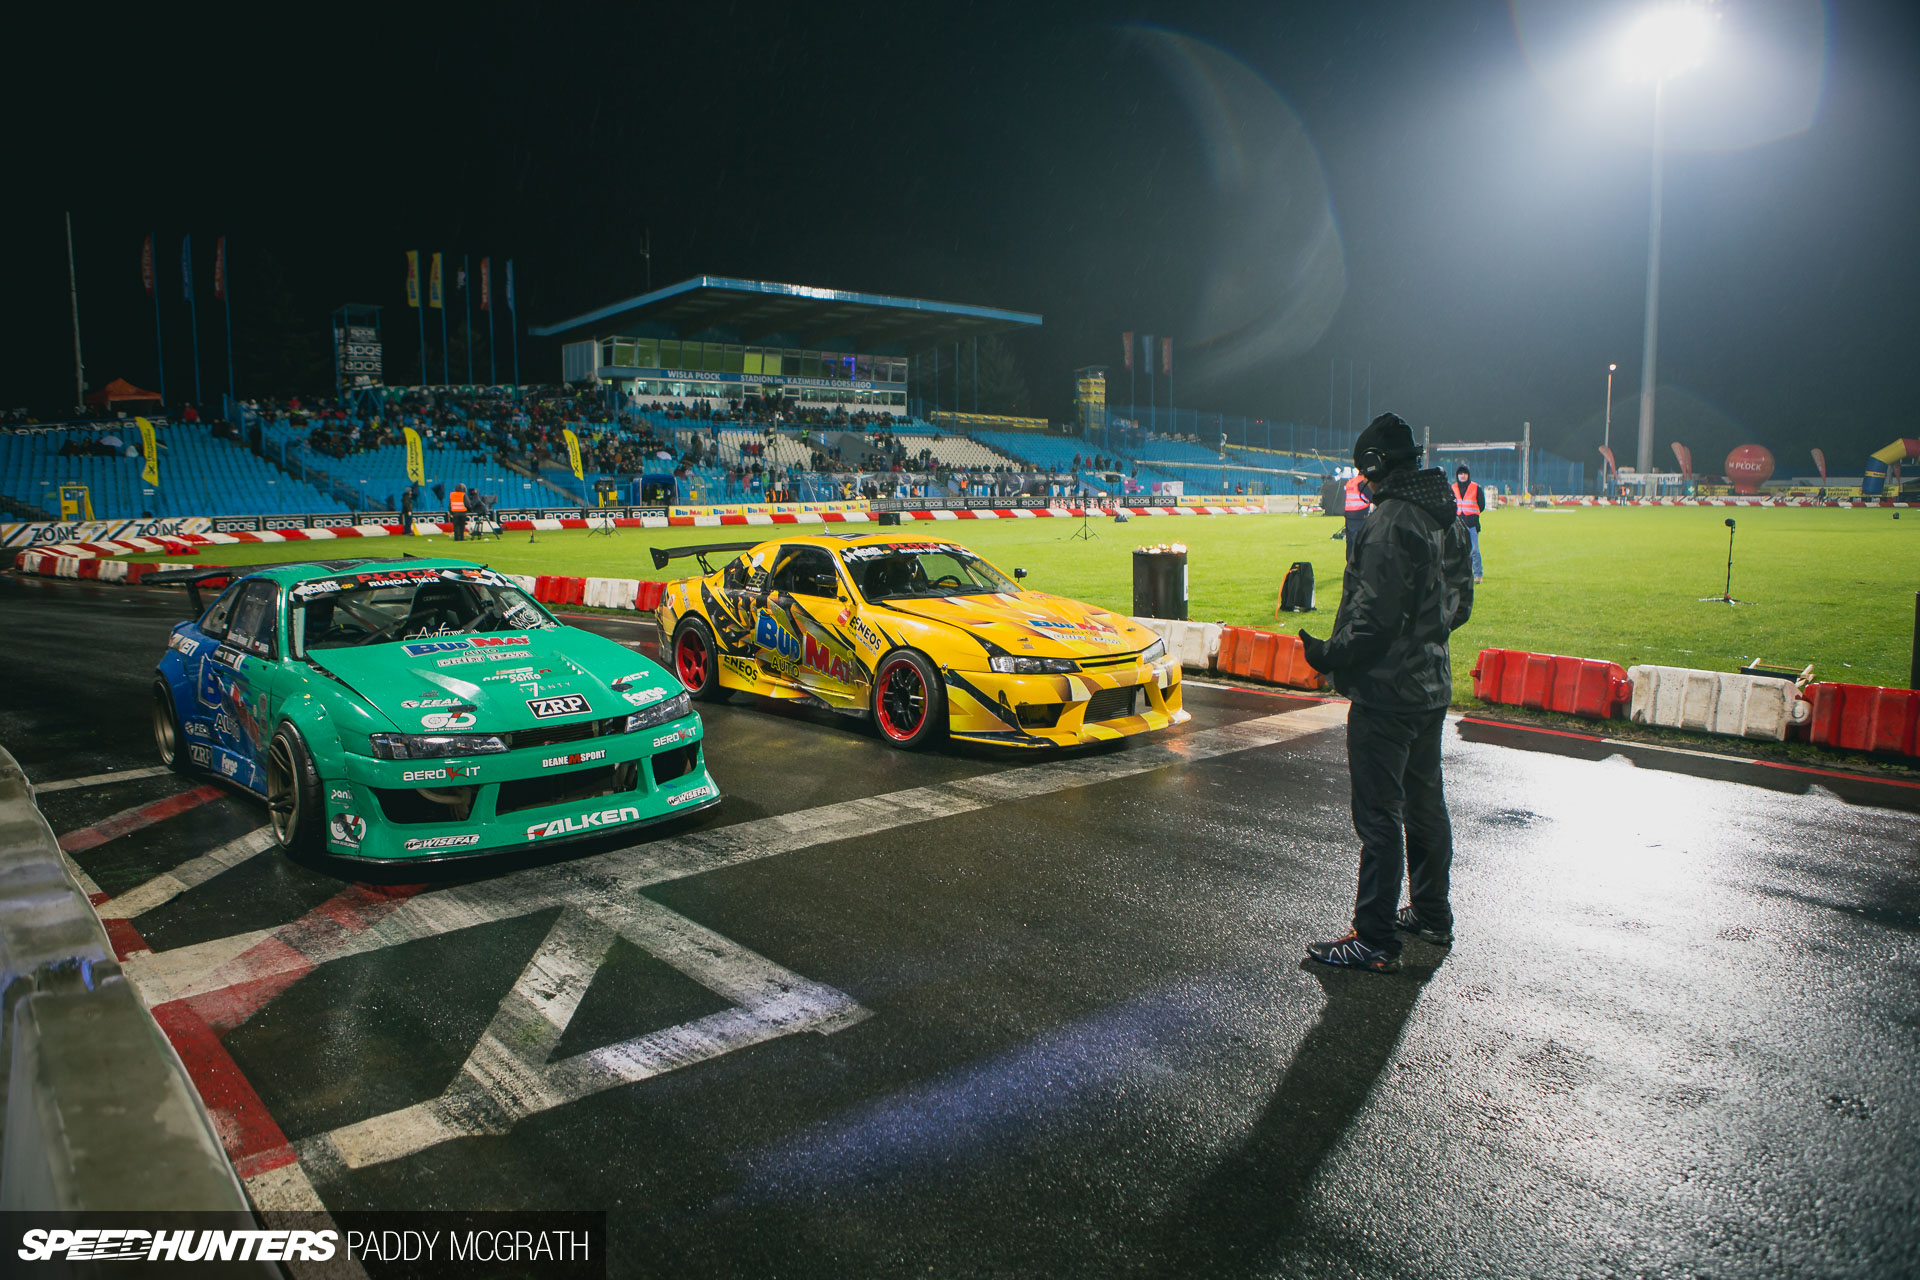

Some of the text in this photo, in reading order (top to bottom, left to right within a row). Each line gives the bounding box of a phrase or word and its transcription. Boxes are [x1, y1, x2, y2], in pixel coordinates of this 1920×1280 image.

[695, 371, 721, 381] PŁOCK
[740, 374, 774, 384] STADION
[786, 377, 830, 387] KAZIMIERZA
[967, 500, 990, 508] epos
[994, 500, 1018, 508] epos
[1021, 500, 1045, 508] epos
[216, 521, 257, 534] epos
[266, 518, 305, 531] epos
[313, 517, 353, 529] epos
[361, 515, 400, 527] epos
[32, 525, 81, 542] ZONE
[136, 522, 185, 537] ZONE
[356, 570, 441, 583] PŁOCK
[368, 578, 412, 588] RUNDA
[1026, 620, 1075, 629] BUD
[401, 635, 532, 657] BUD MAT
[755, 608, 801, 663] BUD
[803, 631, 851, 685] MAT
[723, 655, 758, 681] ENEOS
[771, 655, 800, 678] AUTO
[531, 696, 583, 717] ZRP
[653, 726, 697, 748] AEROKIT
[403, 766, 481, 782] AEROKIT
[524, 807, 640, 841] FALKEN
[423, 833, 480, 849] WISEFAB
